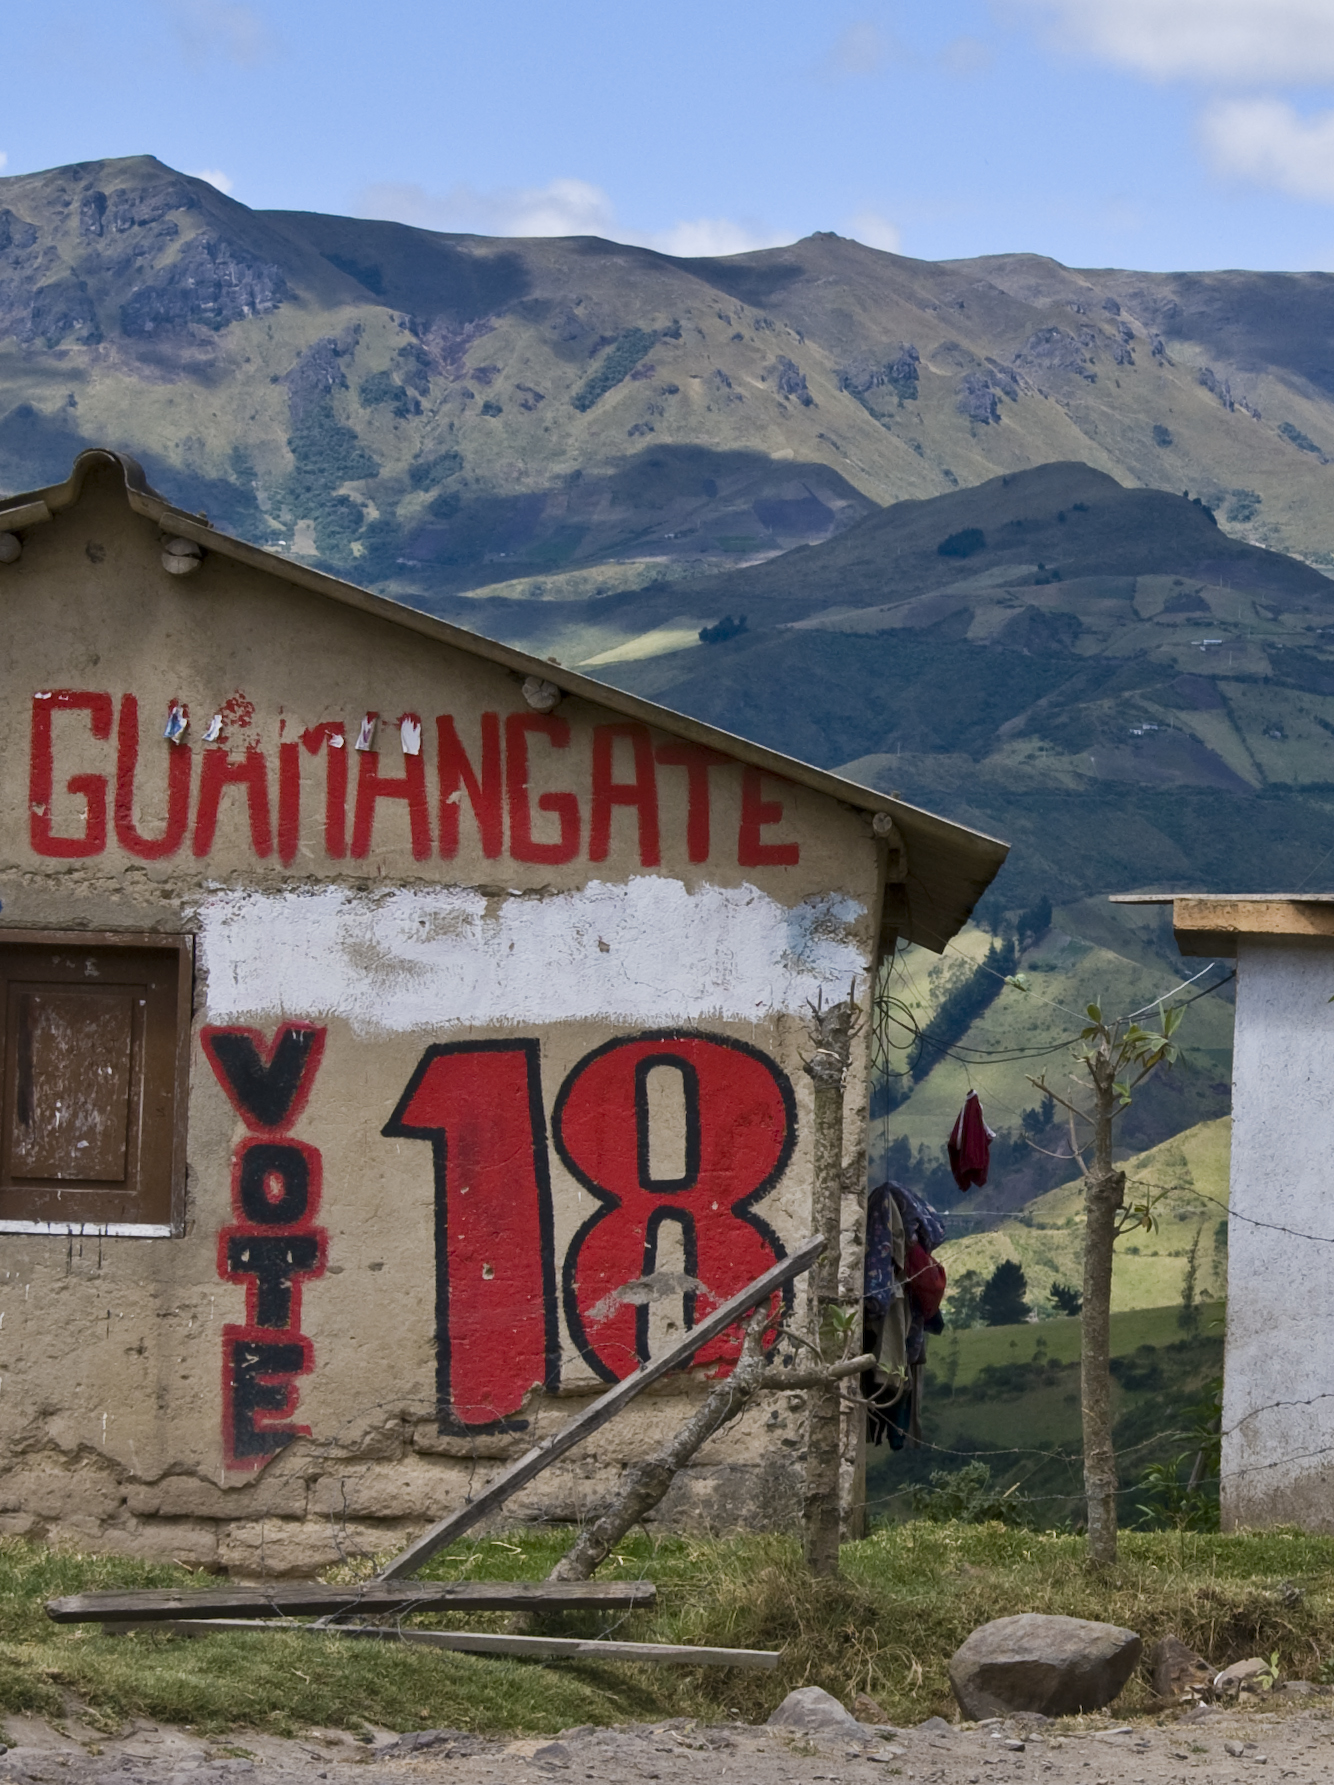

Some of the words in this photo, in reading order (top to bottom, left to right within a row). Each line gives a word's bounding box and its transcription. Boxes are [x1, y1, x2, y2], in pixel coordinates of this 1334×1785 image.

[29, 688, 801, 868] GUAMANGATE
[200, 1020, 328, 1471] VOTE
[380, 1028, 799, 1437] 18
